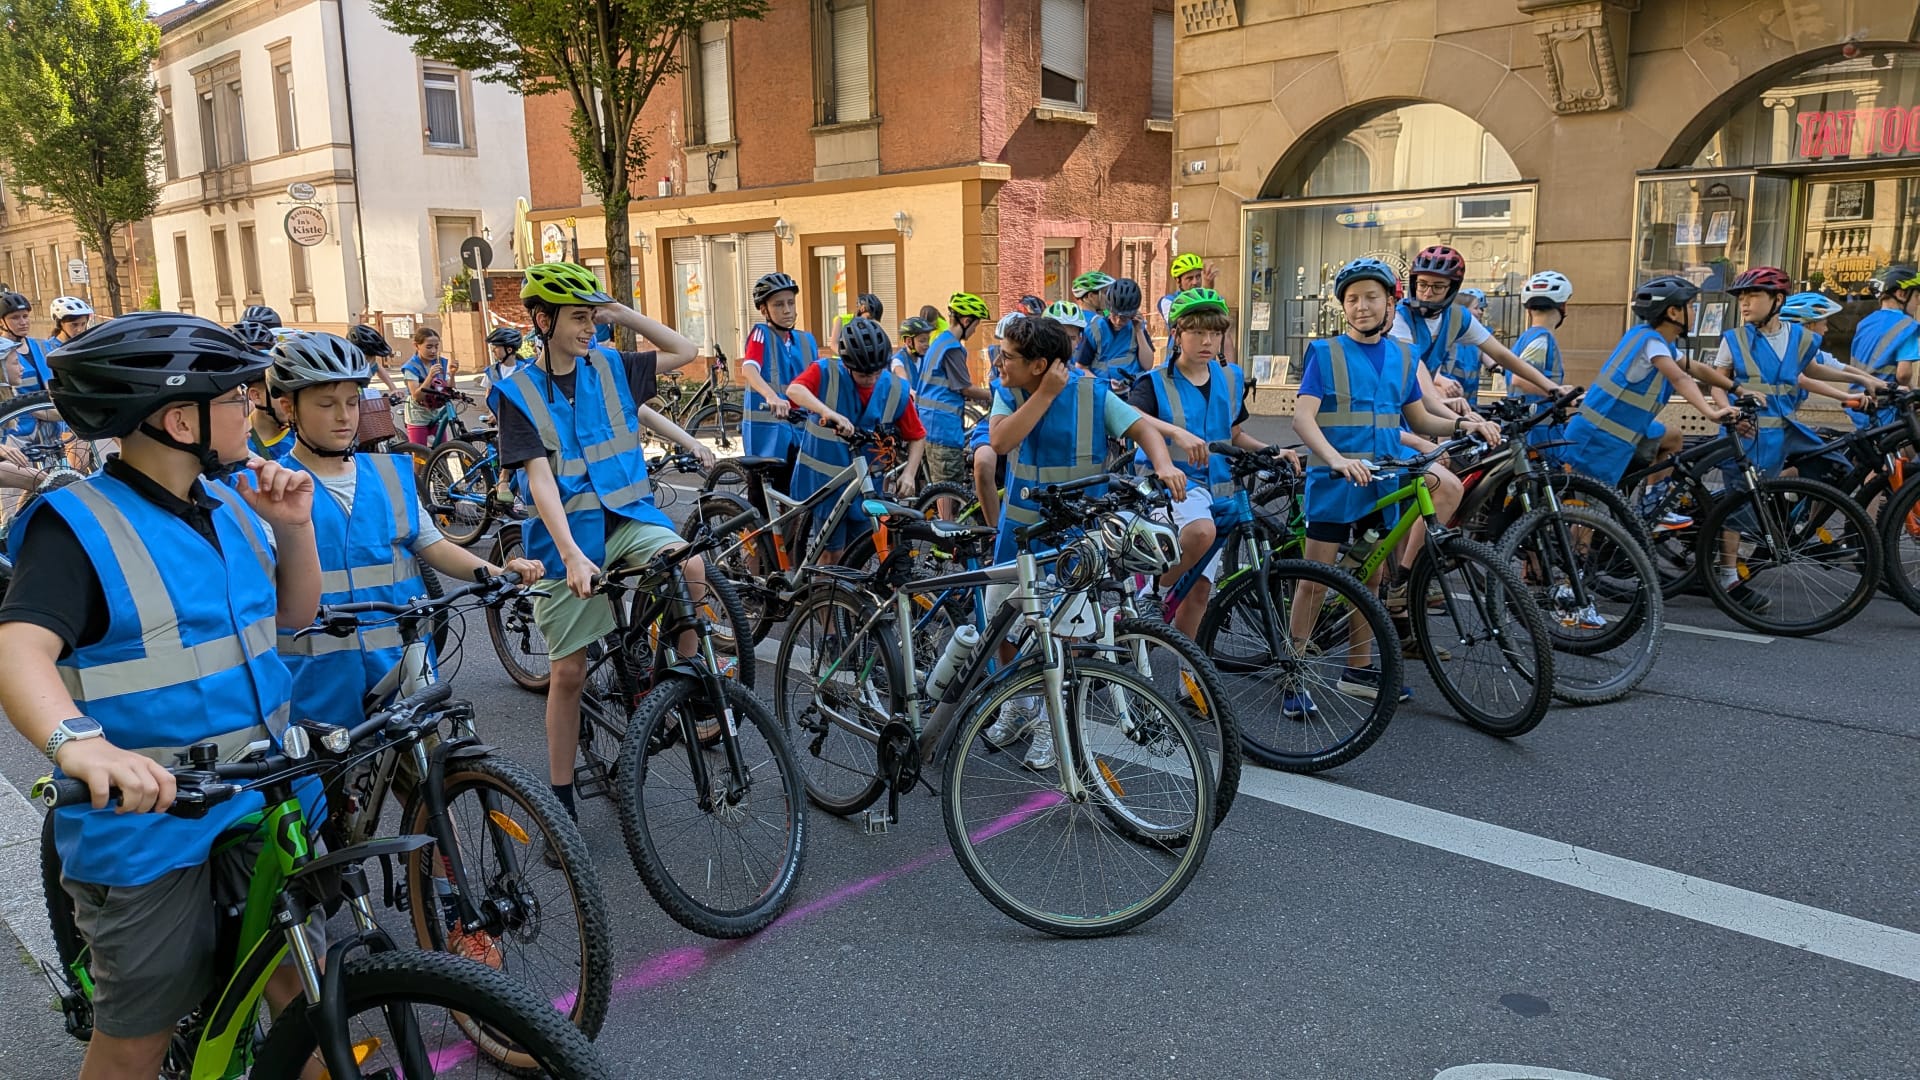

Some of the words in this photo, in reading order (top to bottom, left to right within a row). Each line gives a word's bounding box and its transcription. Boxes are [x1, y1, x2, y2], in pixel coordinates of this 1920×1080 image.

[290, 209, 322, 221] Restaurant
[293, 226, 323, 234] Kistle
[1836, 256, 1877, 272] WINNER
[957, 621, 996, 684] CUBE
[778, 854, 799, 896] SMART
